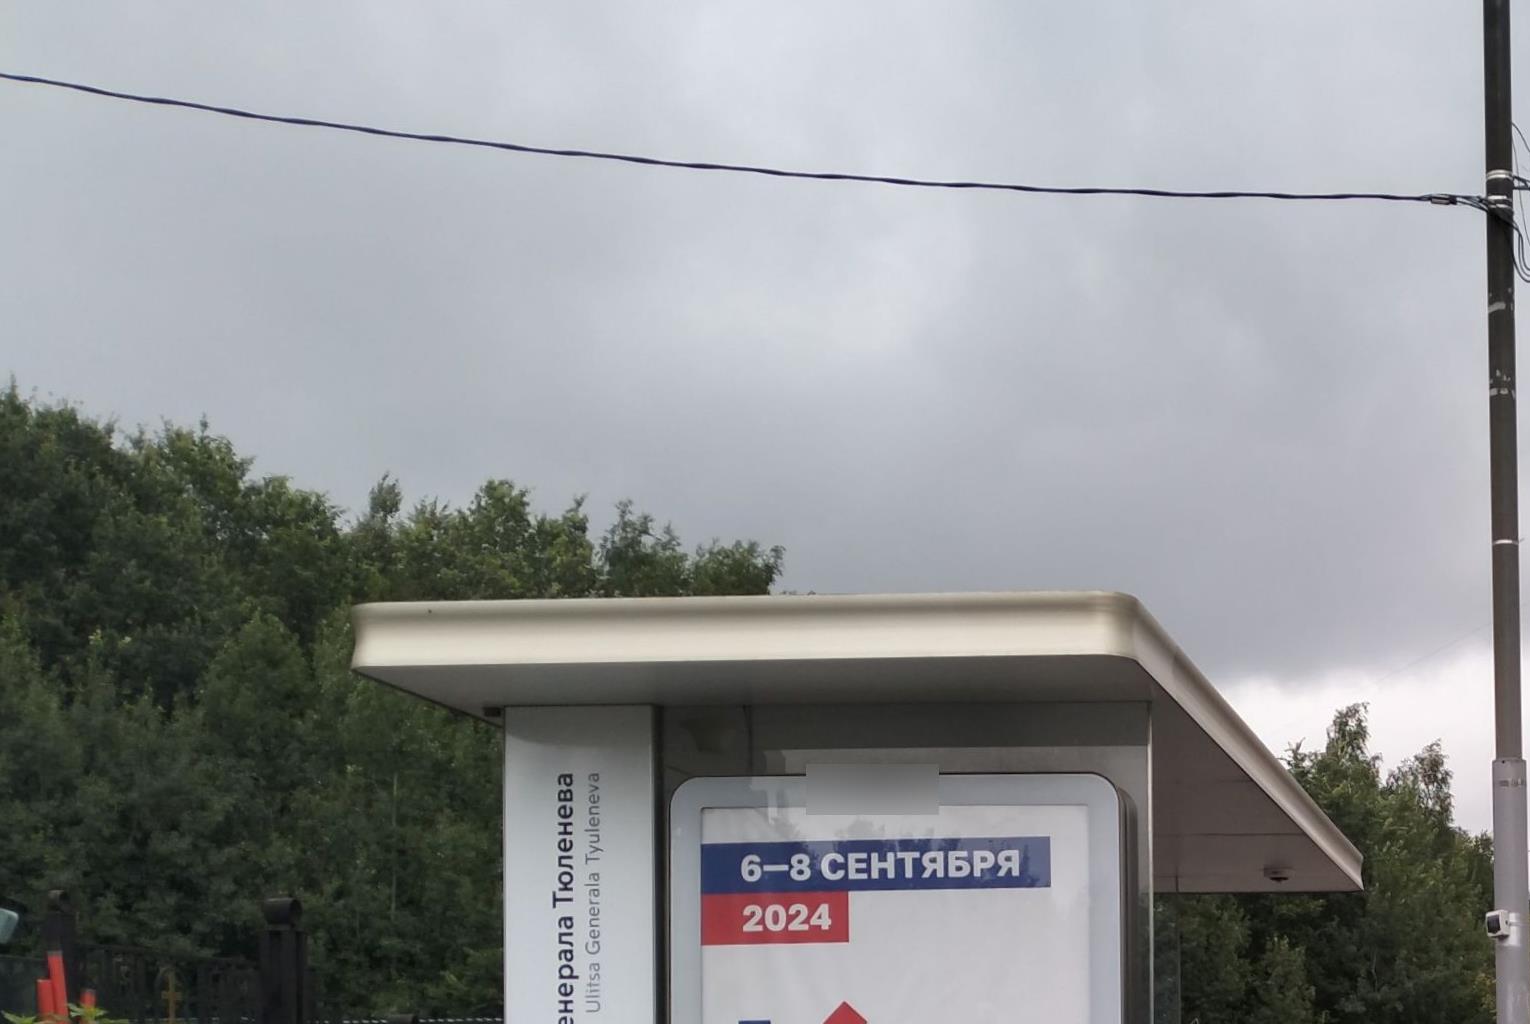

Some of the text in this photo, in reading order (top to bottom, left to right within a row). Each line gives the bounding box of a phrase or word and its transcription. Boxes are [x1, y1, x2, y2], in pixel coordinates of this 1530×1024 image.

[552, 772, 575, 909] Тюленева
[820, 849, 1020, 881] СЕНТЯБРЯ
[584, 772, 604, 1013] Ulitsa Generala Tyuleneva
[742, 903, 832, 932] 2024
